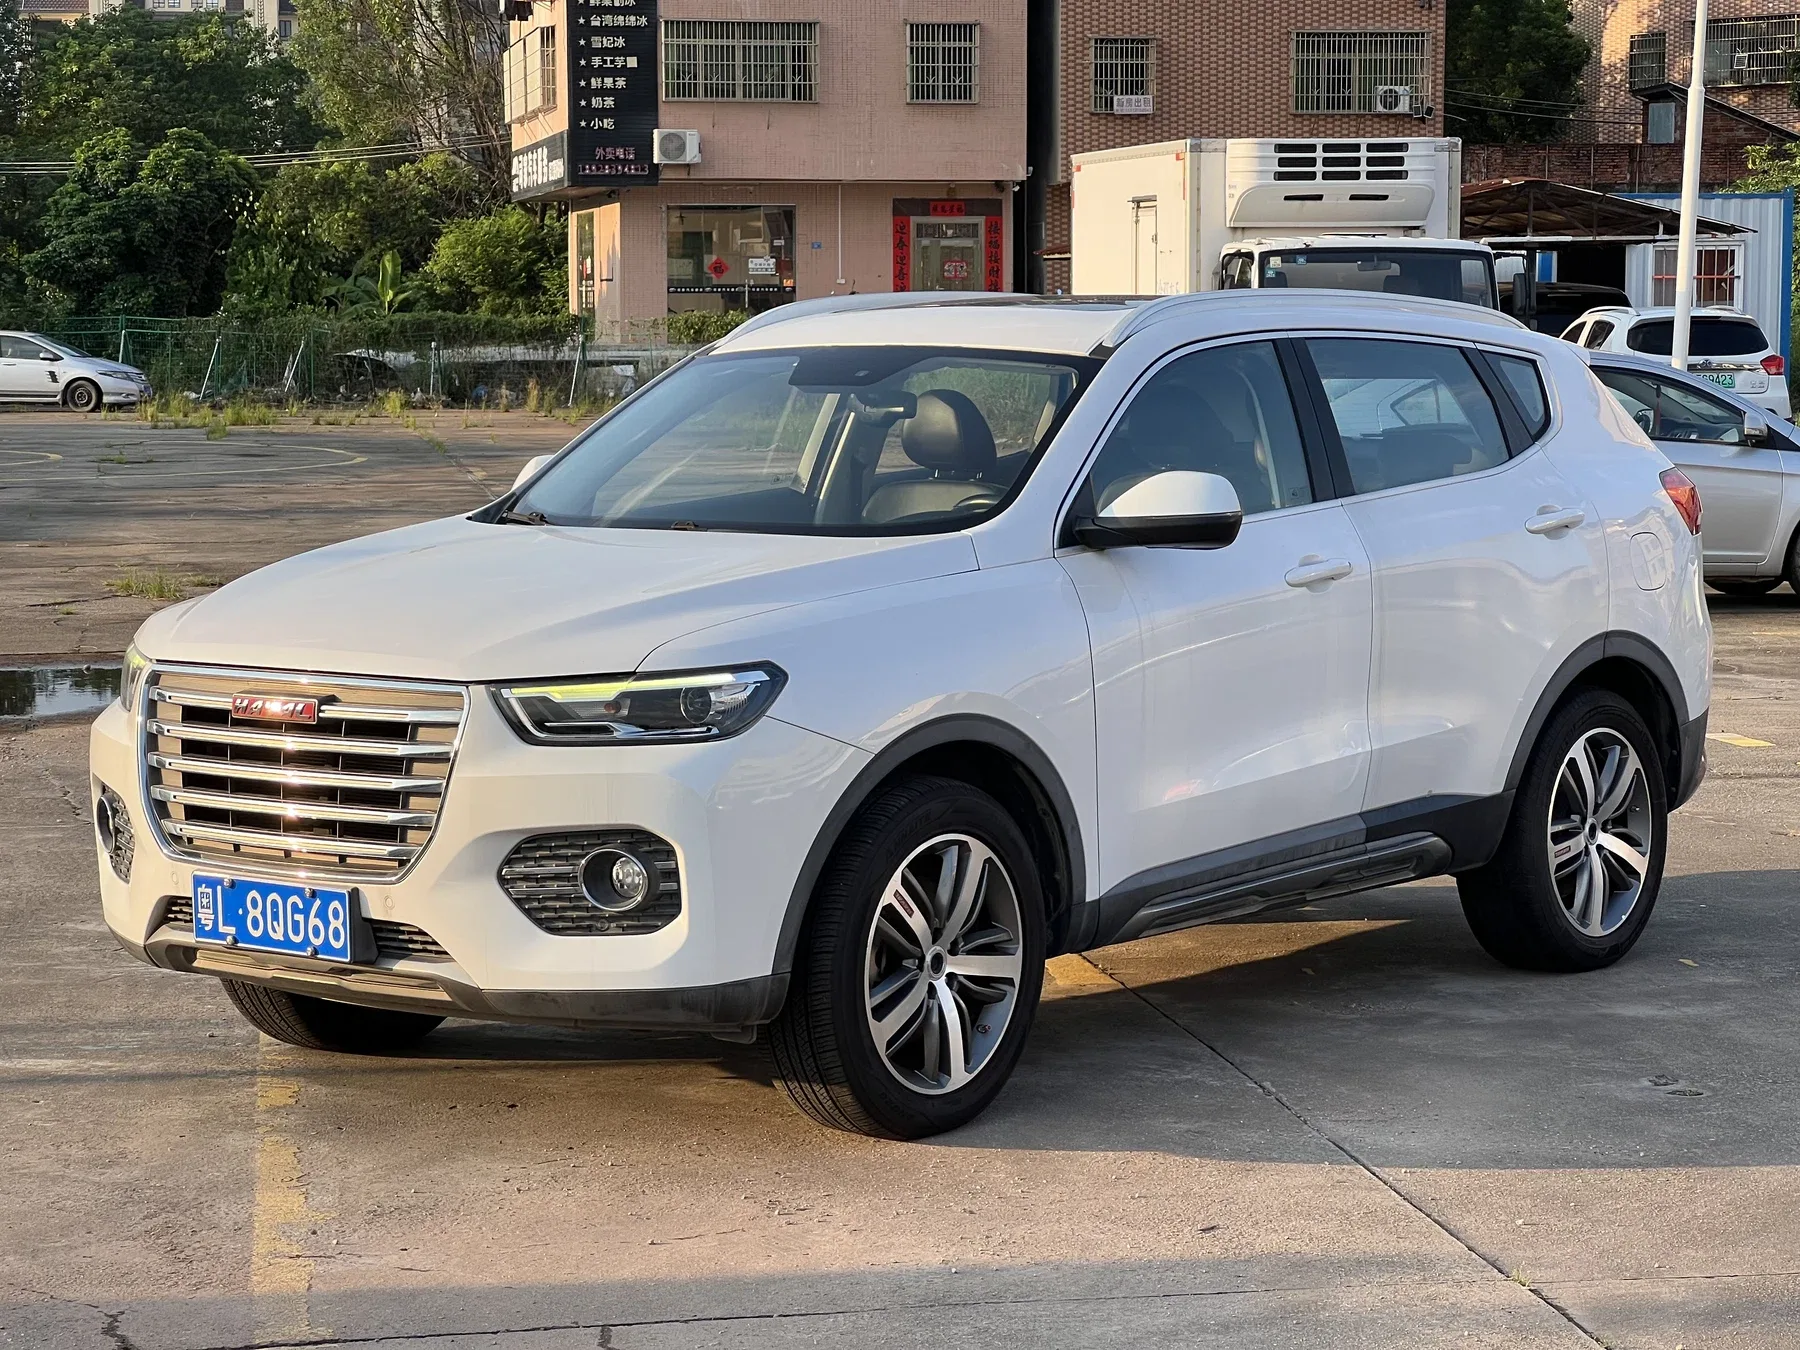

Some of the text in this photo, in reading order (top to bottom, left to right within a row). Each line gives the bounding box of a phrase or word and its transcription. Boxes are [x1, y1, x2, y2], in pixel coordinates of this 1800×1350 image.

[590, 14, 648, 27] 台湾绵绵冰
[590, 36, 626, 48] 雪妃冰
[590, 56, 638, 68] 手工芋
[590, 77, 627, 89] 鲜果茶
[591, 96, 615, 109] 奶茶
[1116, 97, 1152, 107] 新房出租
[590, 117, 615, 130] 小吃
[595, 147, 636, 160] 外卖电话
